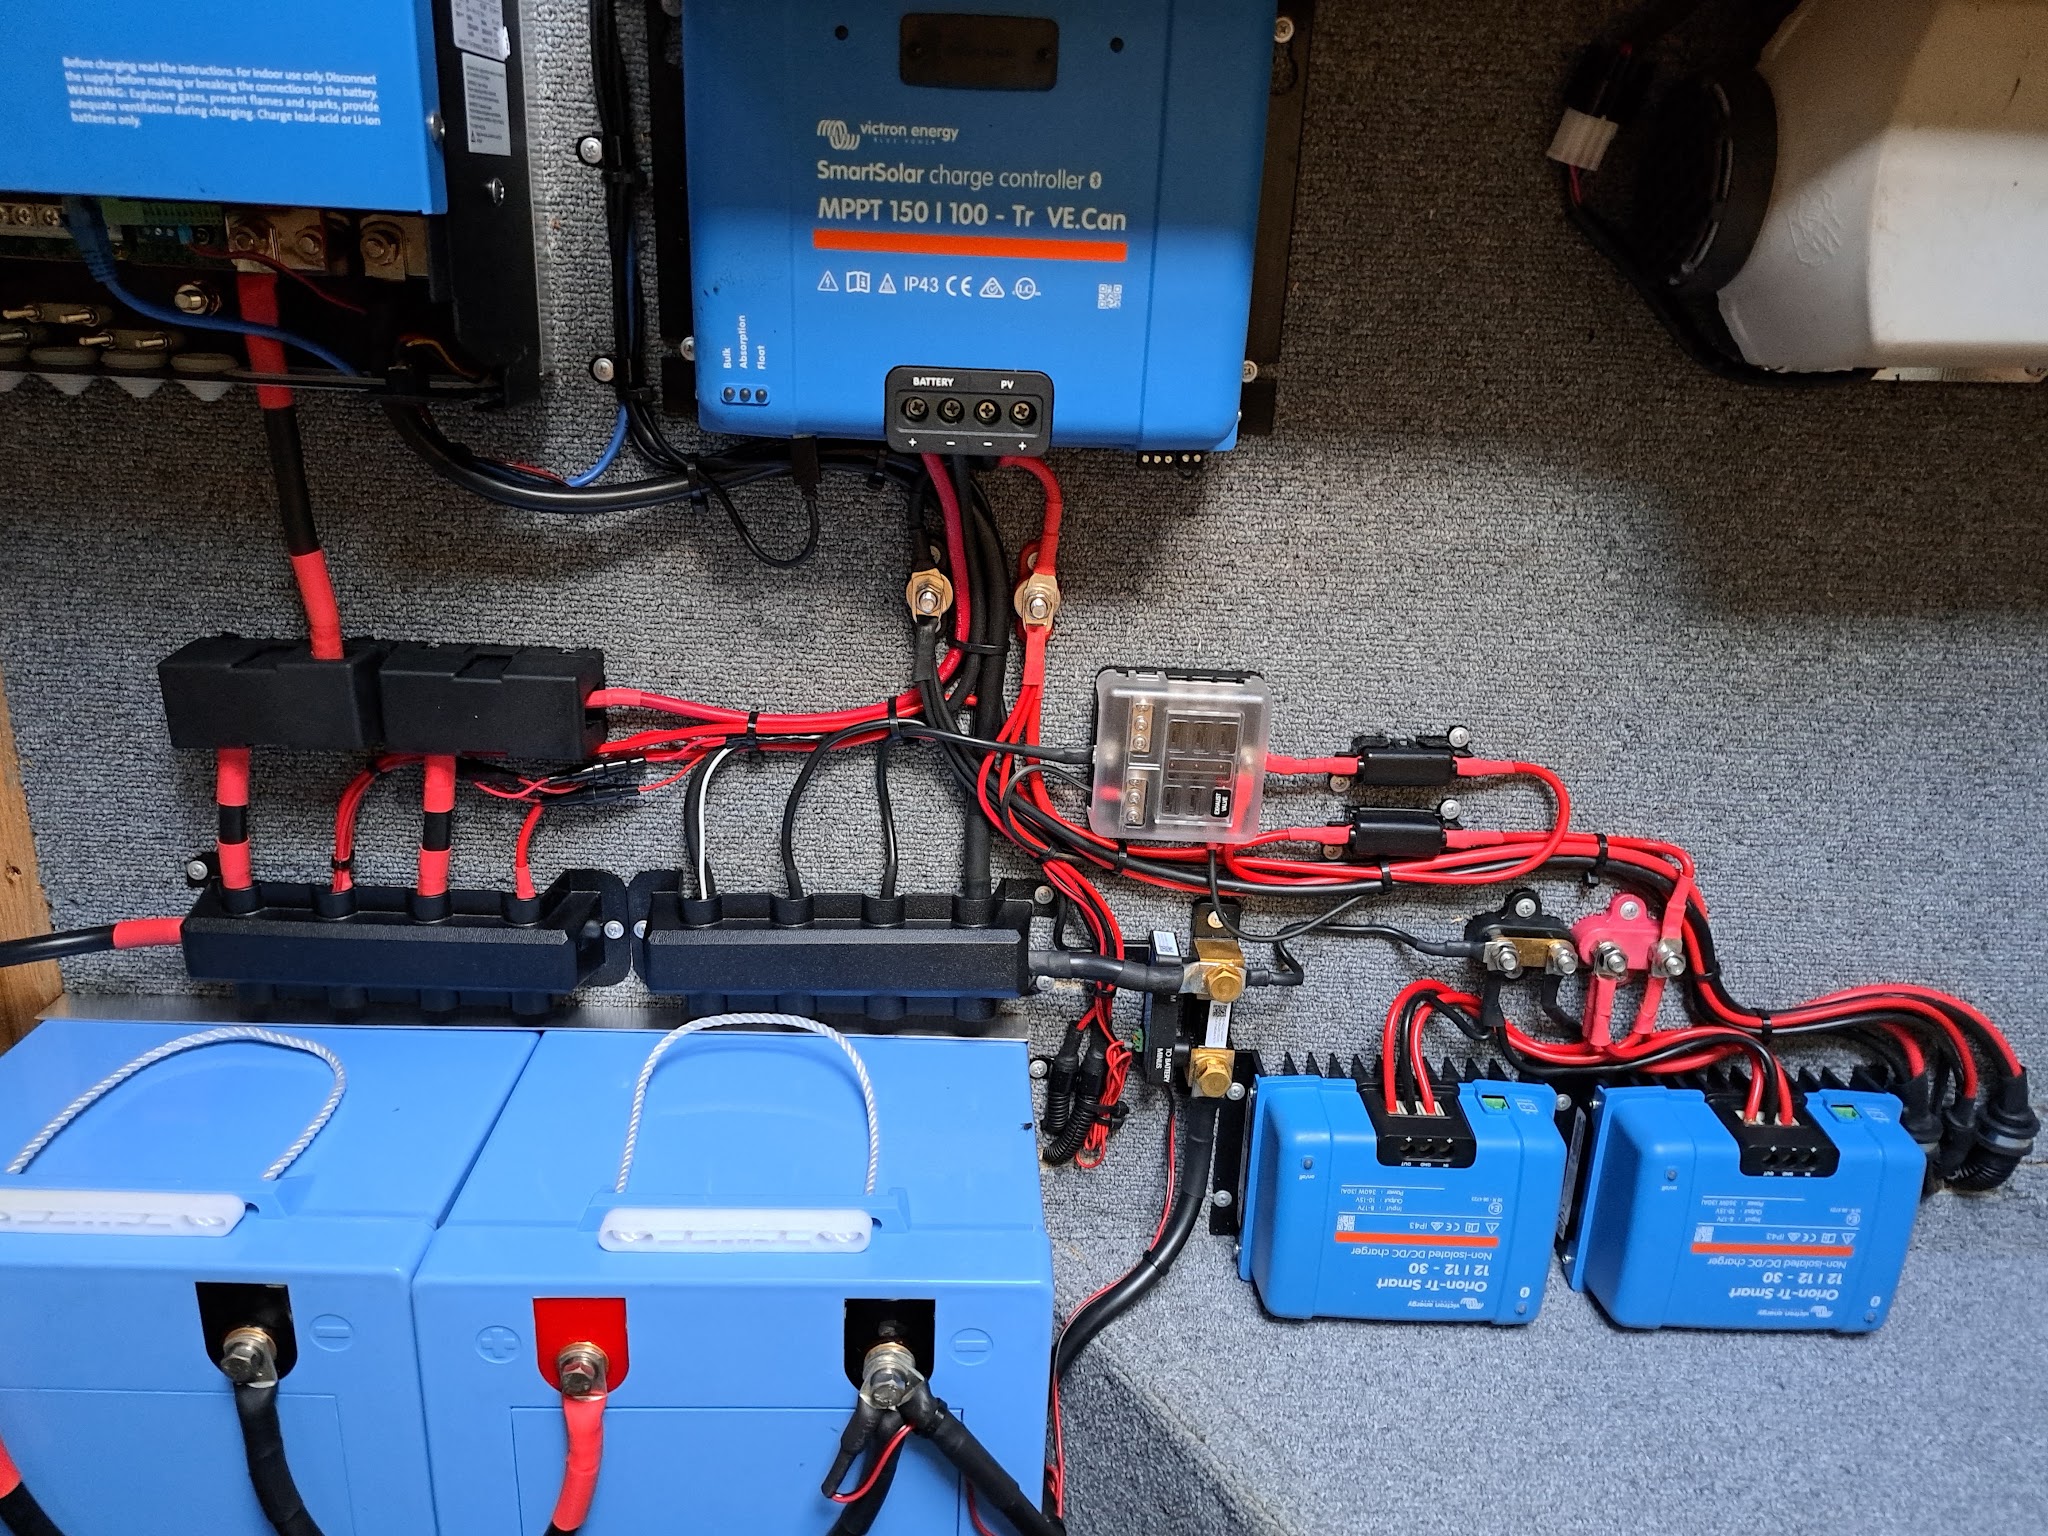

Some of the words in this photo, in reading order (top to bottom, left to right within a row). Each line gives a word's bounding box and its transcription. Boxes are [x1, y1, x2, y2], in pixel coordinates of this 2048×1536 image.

[63, 57, 94, 68] Before
[95, 60, 137, 74] charging
[138, 63, 159, 73] read
[160, 63, 177, 73] the
[236, 68, 251, 77] For
[253, 68, 283, 79] indoor
[285, 72, 300, 81] use
[326, 73, 376, 84] Disconnect
[65, 71, 82, 82] the
[83, 74, 114, 86] supply
[115, 74, 146, 85] before
[147, 77, 184, 90] making
[184, 80, 194, 88] or
[196, 78, 237, 93] breaking
[238, 81, 254, 91] the
[255, 82, 311, 95] connections
[313, 86, 323, 95] to
[325, 86, 341, 96] the
[343, 88, 377, 100] battery.
[67, 85, 127, 98] WARNING:
[129, 88, 176, 100] Explosive
[177, 93, 208, 104] gases,
[210, 95, 247, 105] prevent
[250, 95, 284, 106] flames
[286, 98, 304, 108] and
[307, 100, 341, 111] sparks,
[343, 102, 379, 112] provide
[69, 99, 117, 112] adequate
[118, 103, 173, 113] ventilation
[174, 104, 207, 118] during
[209, 106, 254, 121] charging.
[257, 109, 292, 123] Charge
[294, 111, 340, 123] lead-acid
[341, 115, 352, 124] or
[71, 111, 116, 124] batteries
[860, 121, 907, 136] victron
[911, 124, 959, 143] energy
[817, 160, 925, 183] SmartSolar
[929, 163, 994, 191] charge
[1000, 169, 1085, 190] controller
[818, 196, 883, 221] MPPT
[890, 200, 929, 223] 150
[949, 202, 989, 226] 100
[1012, 205, 1034, 227] Tr
[1047, 206, 1126, 230] VE.Can
[904, 276, 938, 293] IP43
[737, 315, 748, 369] Absorption
[722, 348, 731, 369] Bulk
[757, 345, 766, 369] Float
[913, 377, 954, 387] BATTERY
[1001, 380, 1014, 389] PV
[1166, 1048, 1172, 1057] TO
[1163, 1058, 1171, 1083] BATTERY
[1351, 1246, 1389, 1256] charger
[1392, 1249, 1425, 1258] DC/DC
[1429, 1250, 1492, 1260] Non-isolated
[1708, 1257, 1746, 1266] charger
[1748, 1258, 1781, 1268] DC/DC
[1784, 1259, 1847, 1269] Non-isolated
[1409, 1263, 1429, 1274] 30
[1444, 1264, 1459, 1276] 12
[1475, 1265, 1490, 1276] 12
[1762, 1272, 1783, 1283] 30
[1798, 1273, 1814, 1284] 12
[1827, 1274, 1843, 1284] 12
[1376, 1278, 1421, 1290] Smart
[1425, 1280, 1487, 1292] Orion-Tr
[1728, 1287, 1774, 1299] Smart
[1777, 1289, 1839, 1301] Orion-Tr
[1408, 1300, 1433, 1308] energy
